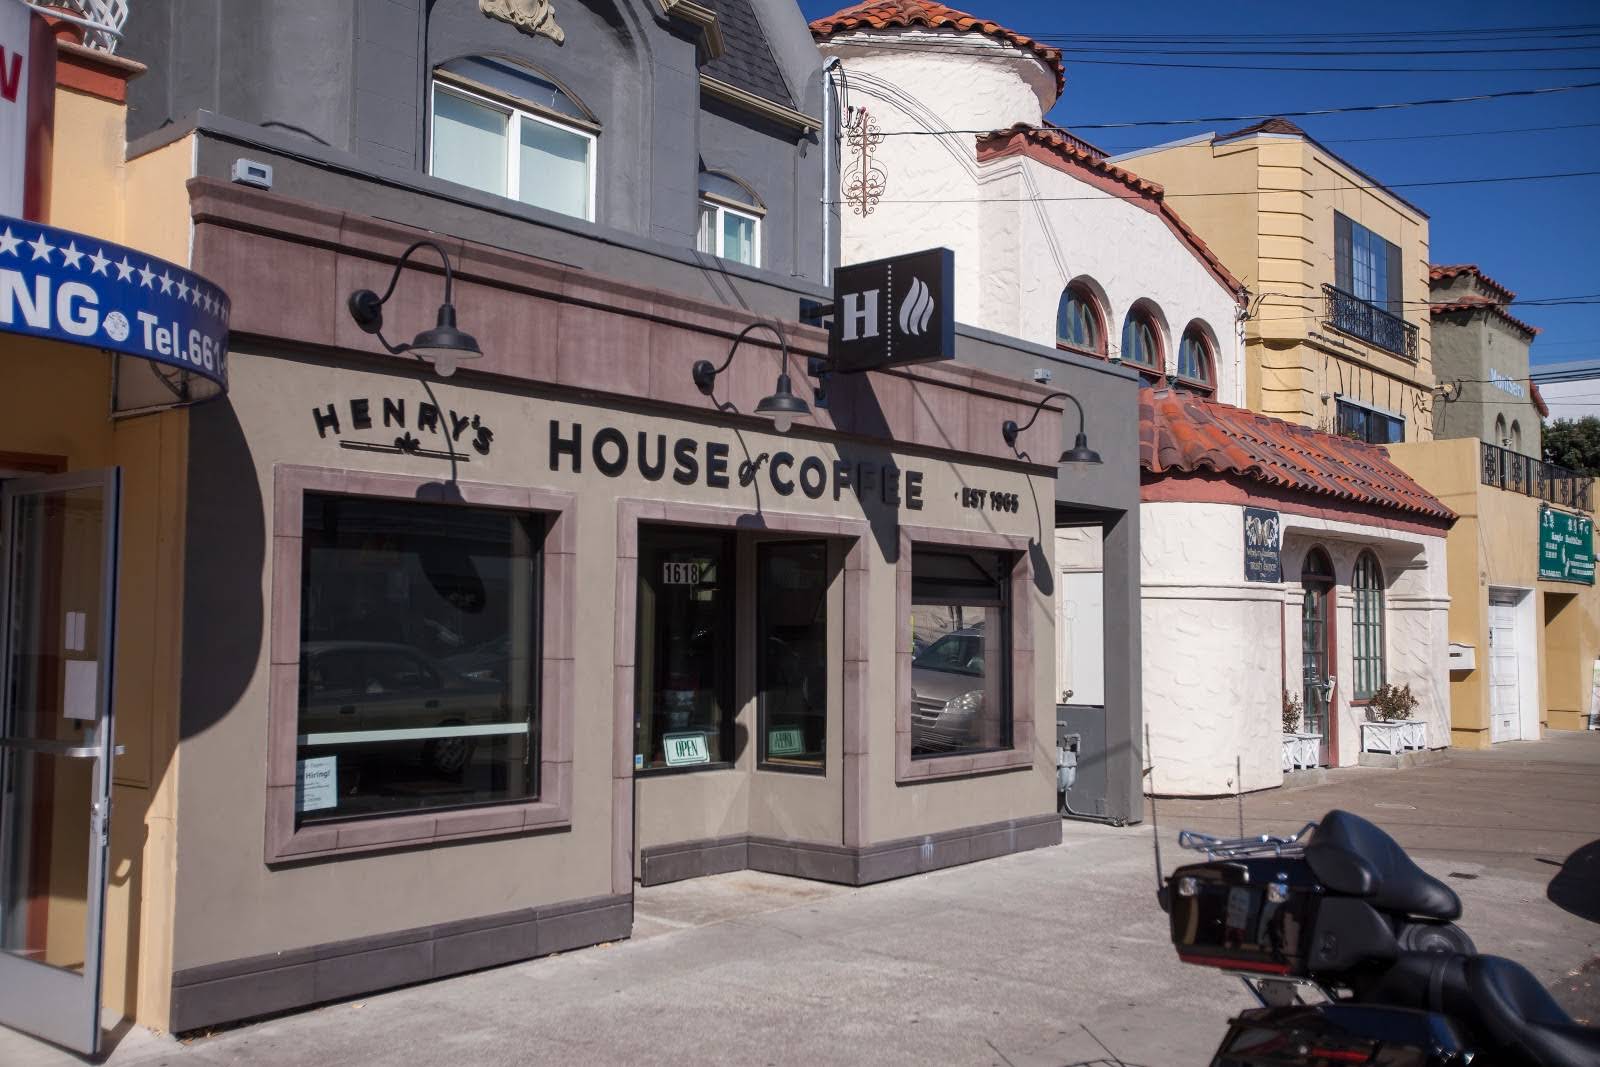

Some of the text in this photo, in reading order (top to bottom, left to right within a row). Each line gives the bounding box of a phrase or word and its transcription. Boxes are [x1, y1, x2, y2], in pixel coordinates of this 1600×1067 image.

[842, 288, 880, 341] H
[312, 397, 494, 455] HENRY'S
[549, 419, 925, 511] HOUSE of COFFEE
[962, 487, 1019, 513] EST 1965
[664, 562, 699, 584] 1618
[675, 739, 699, 758] OPEN
[305, 769, 330, 780] Hiring!
